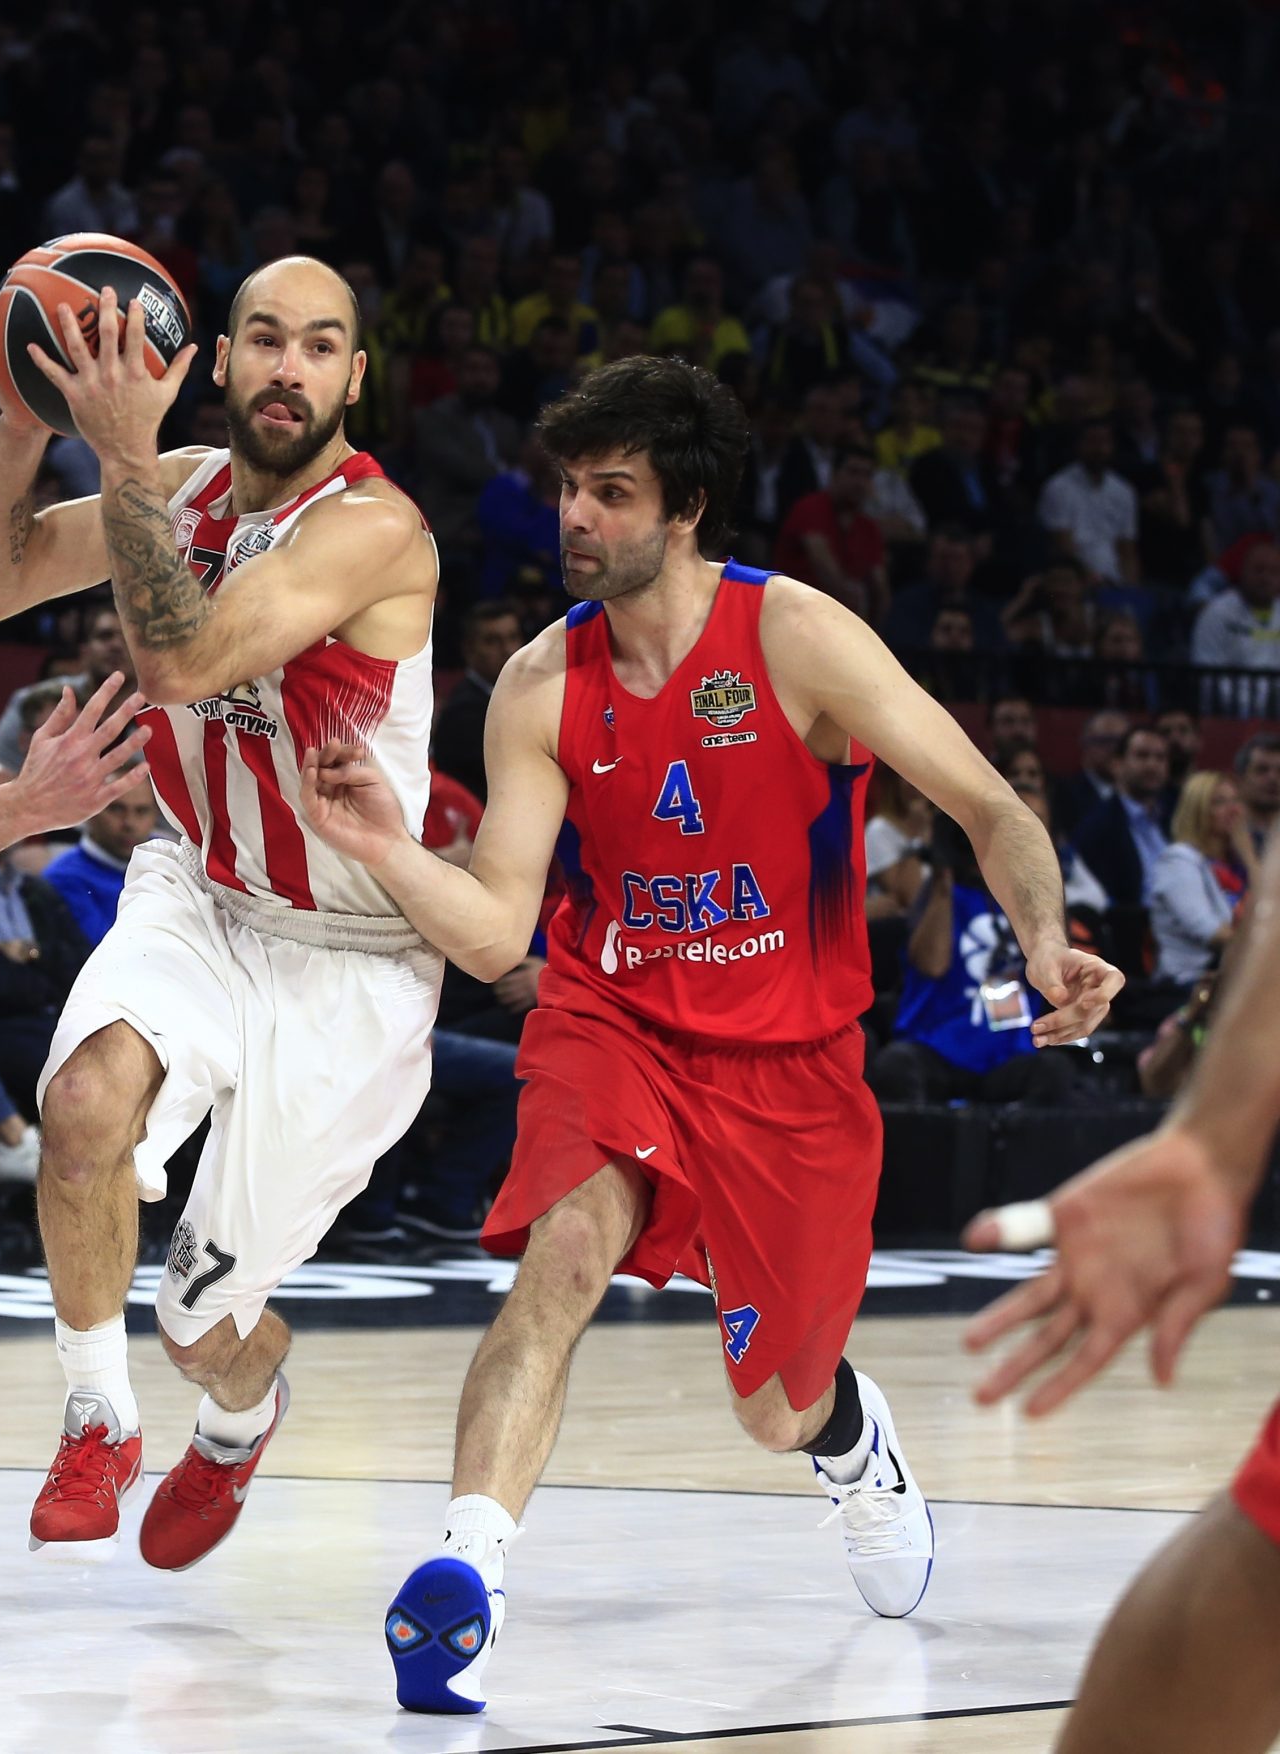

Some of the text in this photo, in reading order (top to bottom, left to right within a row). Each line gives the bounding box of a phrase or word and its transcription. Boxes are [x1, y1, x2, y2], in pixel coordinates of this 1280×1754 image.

[141, 291, 165, 321] FOUR
[191, 547, 225, 595] 7
[694, 688, 751, 708] FINAL FOUR
[652, 759, 705, 835] 4
[621, 863, 770, 934] CSKA
[176, 1244, 193, 1271] FOUR
[179, 1239, 237, 1311] 7
[721, 1304, 761, 1364] 4
